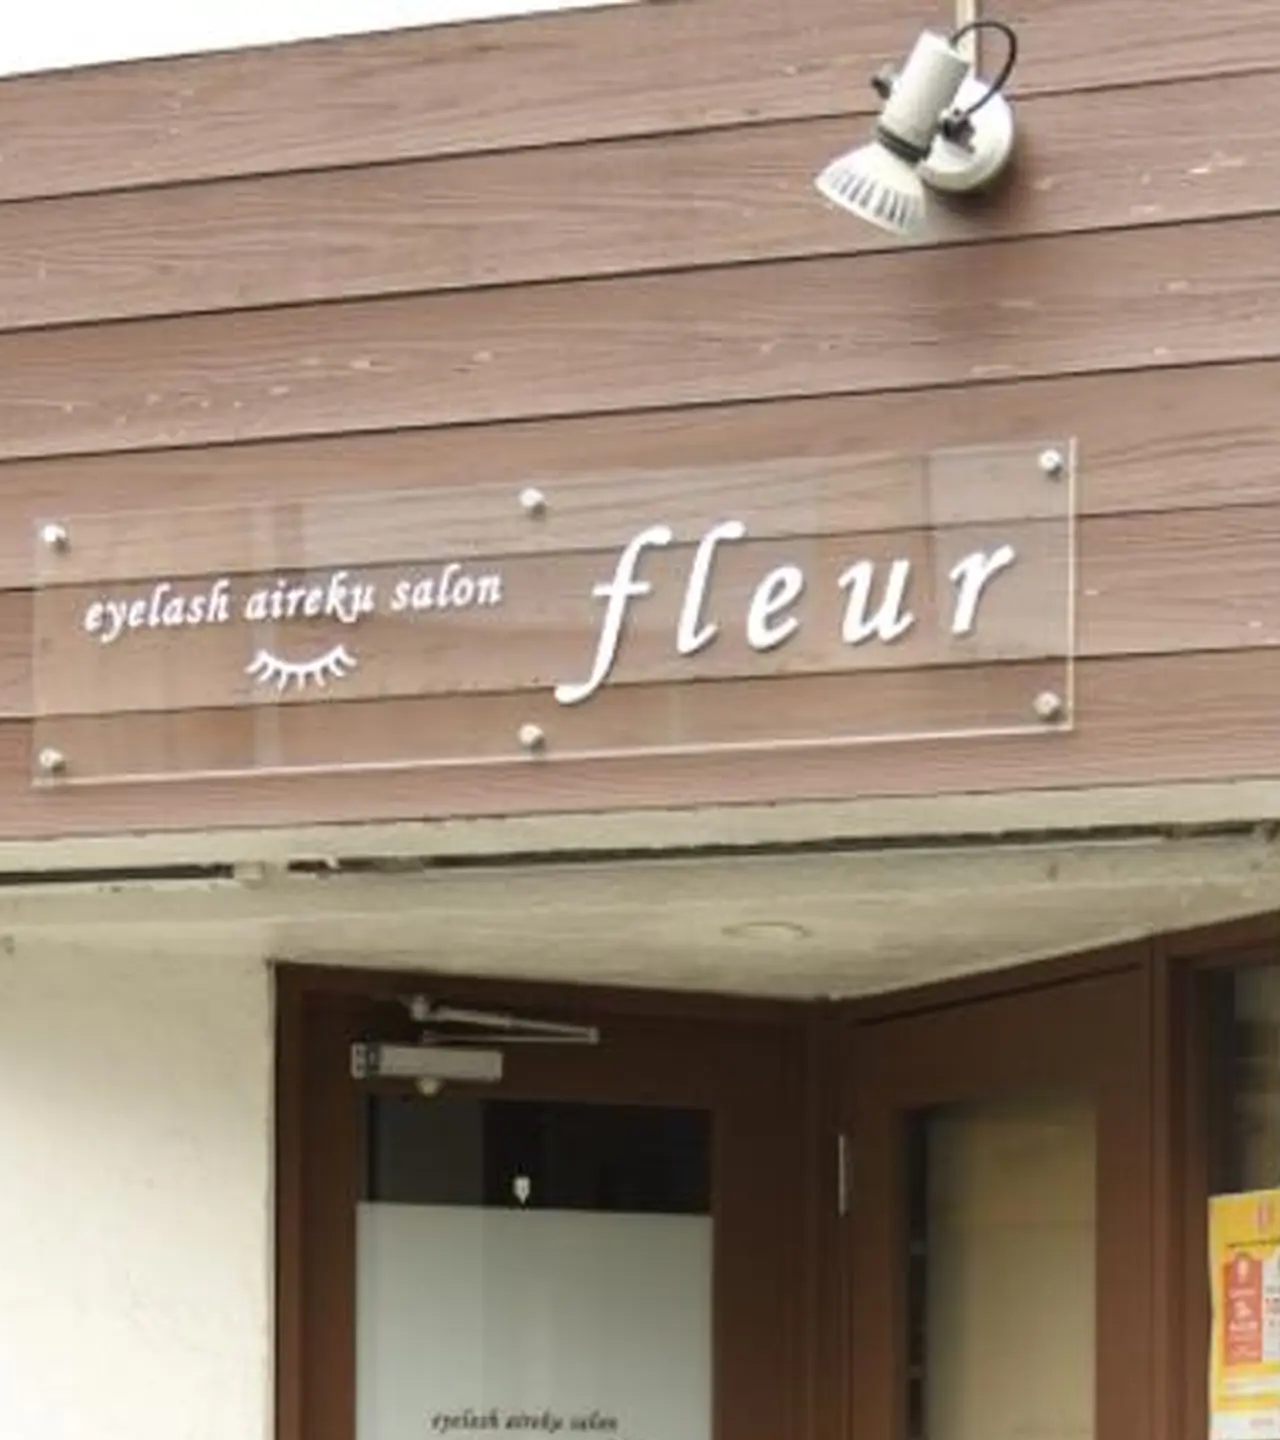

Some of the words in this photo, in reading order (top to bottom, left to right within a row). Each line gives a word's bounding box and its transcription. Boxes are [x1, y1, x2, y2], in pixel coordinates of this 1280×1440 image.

[82, 571, 230, 643] eyelash
[390, 563, 505, 613] salon
[554, 520, 1015, 706] fleur
